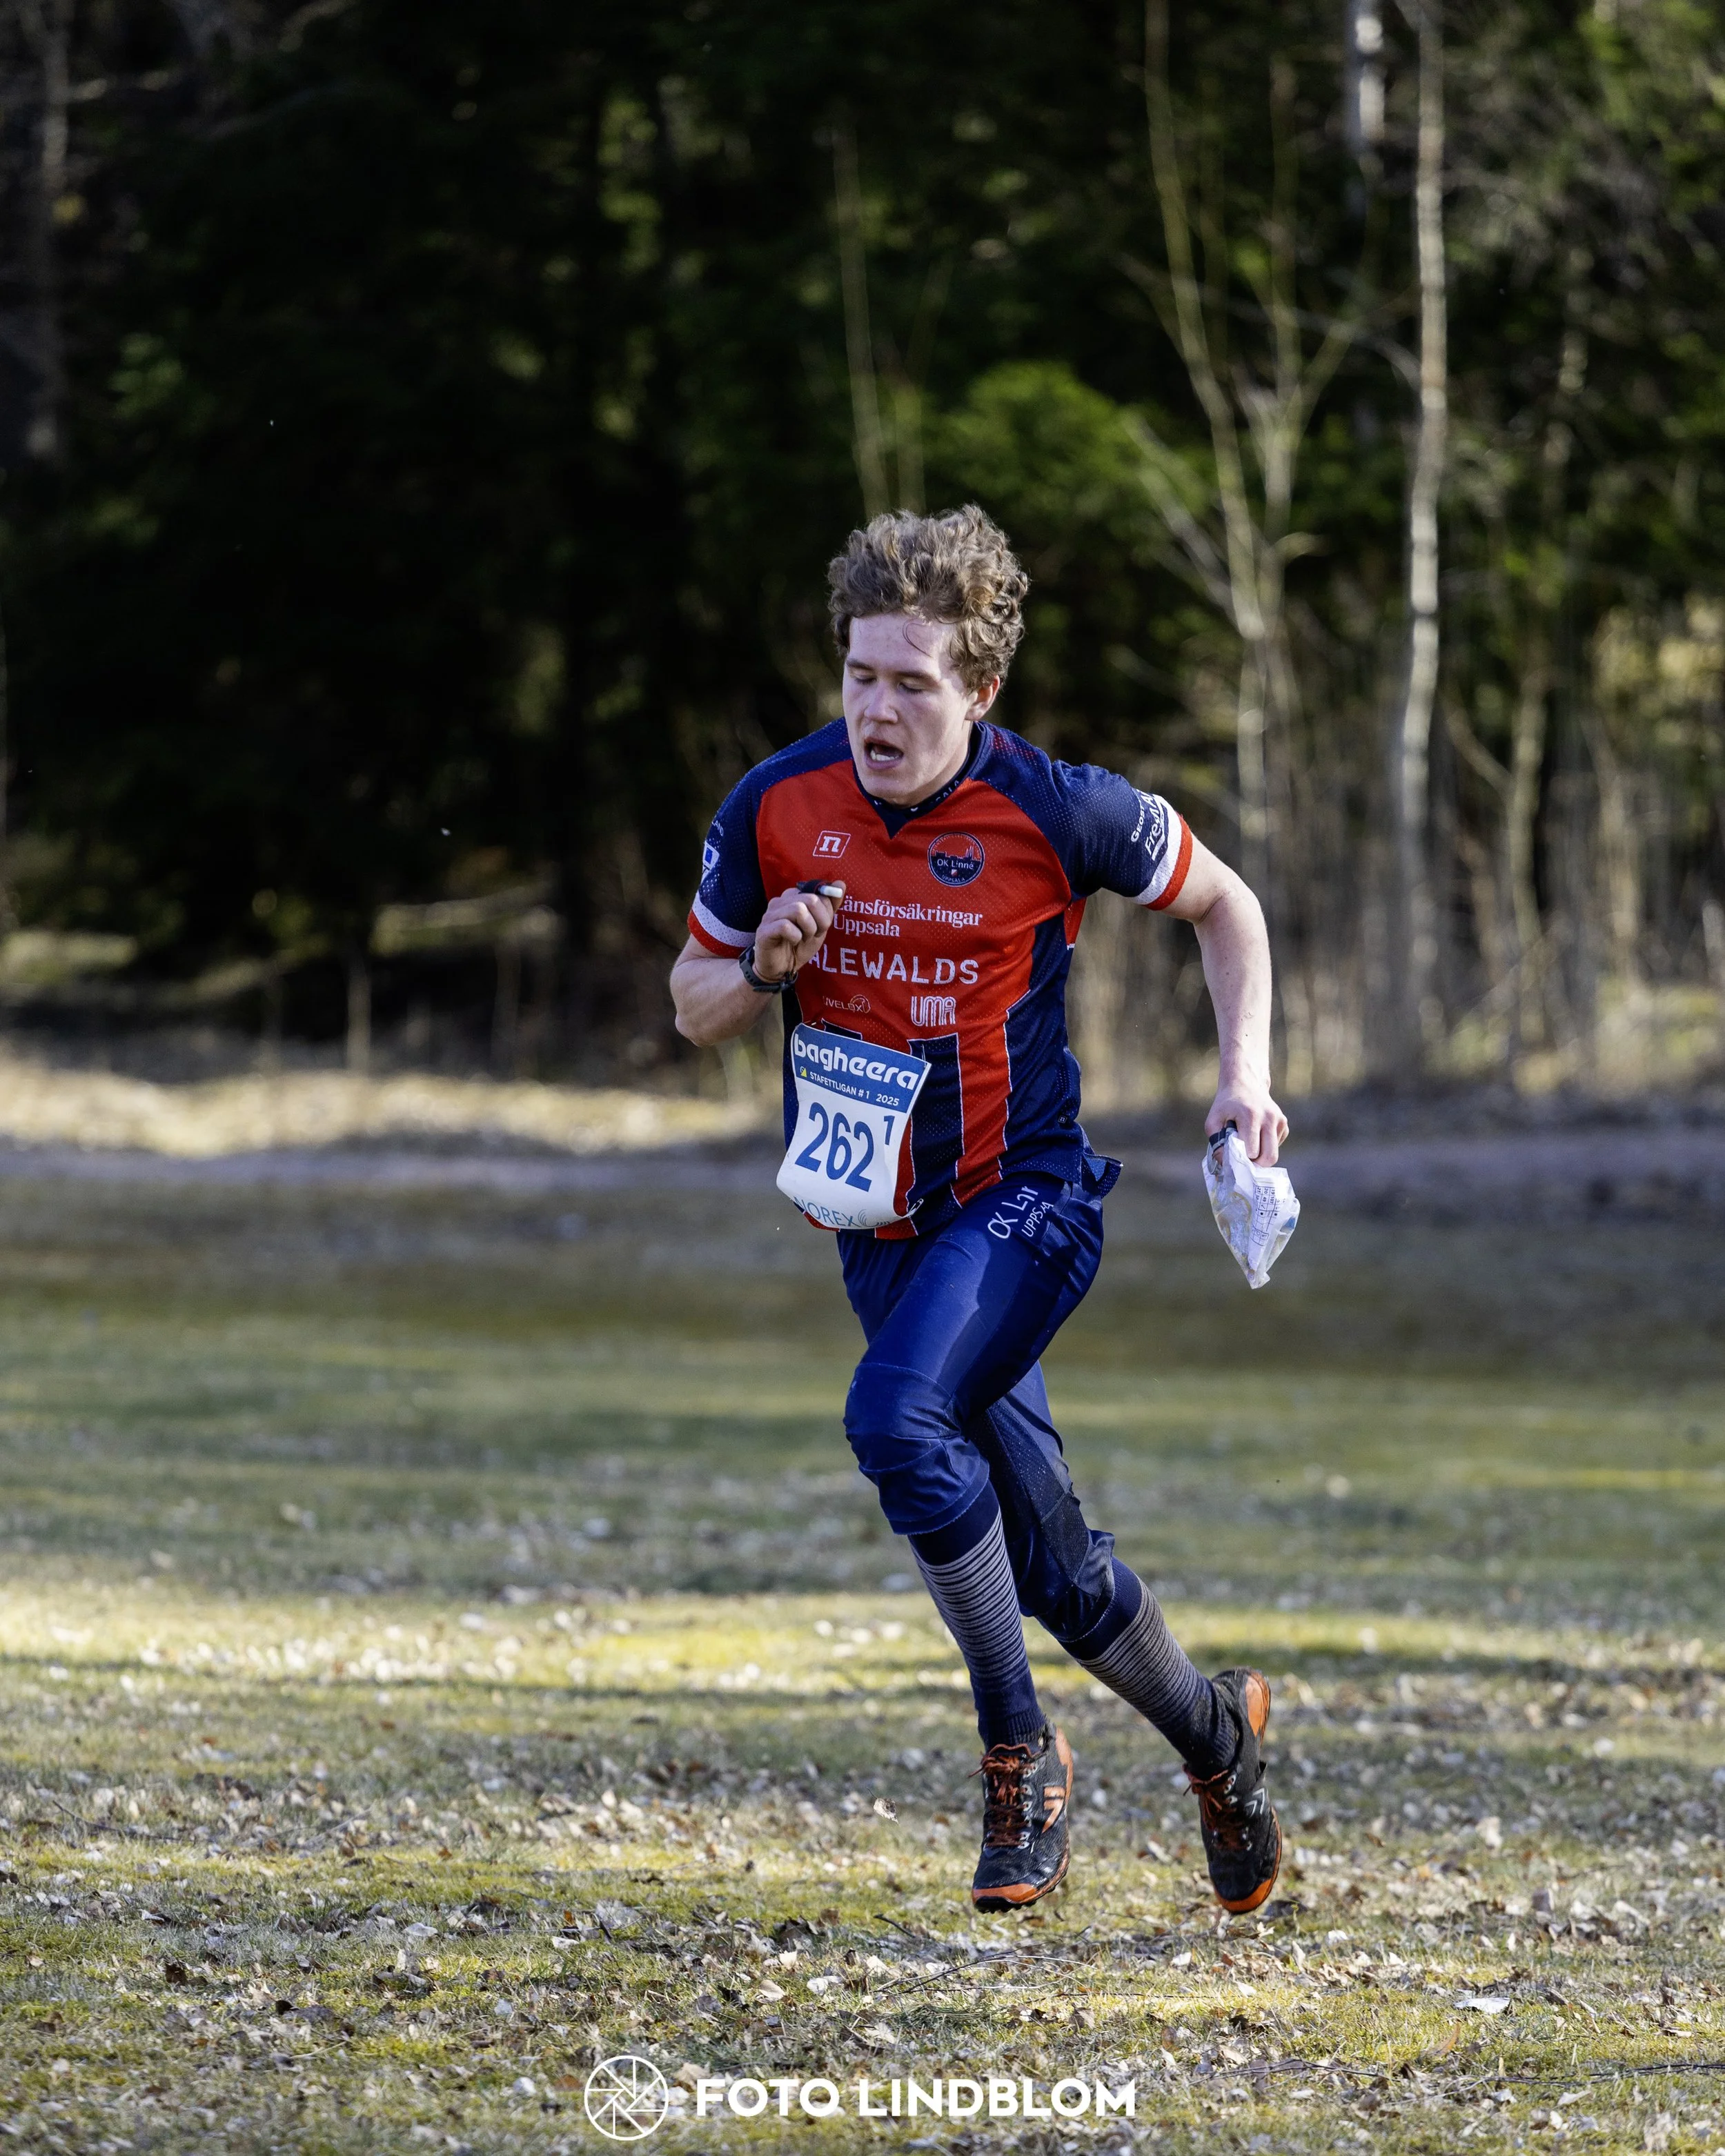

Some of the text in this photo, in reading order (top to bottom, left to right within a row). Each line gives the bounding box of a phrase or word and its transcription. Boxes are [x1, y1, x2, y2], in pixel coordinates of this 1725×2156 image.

[937, 858, 949, 867] OK
[941, 874, 965, 883] UPPSALA
[834, 913, 900, 937] Uppsala
[838, 896, 983, 929] änsförsäkringar
[794, 1034, 919, 1091] bagheera
[809, 1071, 857, 1096] STAFETTLIGAN
[876, 1093, 900, 1107] 2025
[794, 1102, 874, 1193] 262
[793, 1196, 862, 1227] NOREX
